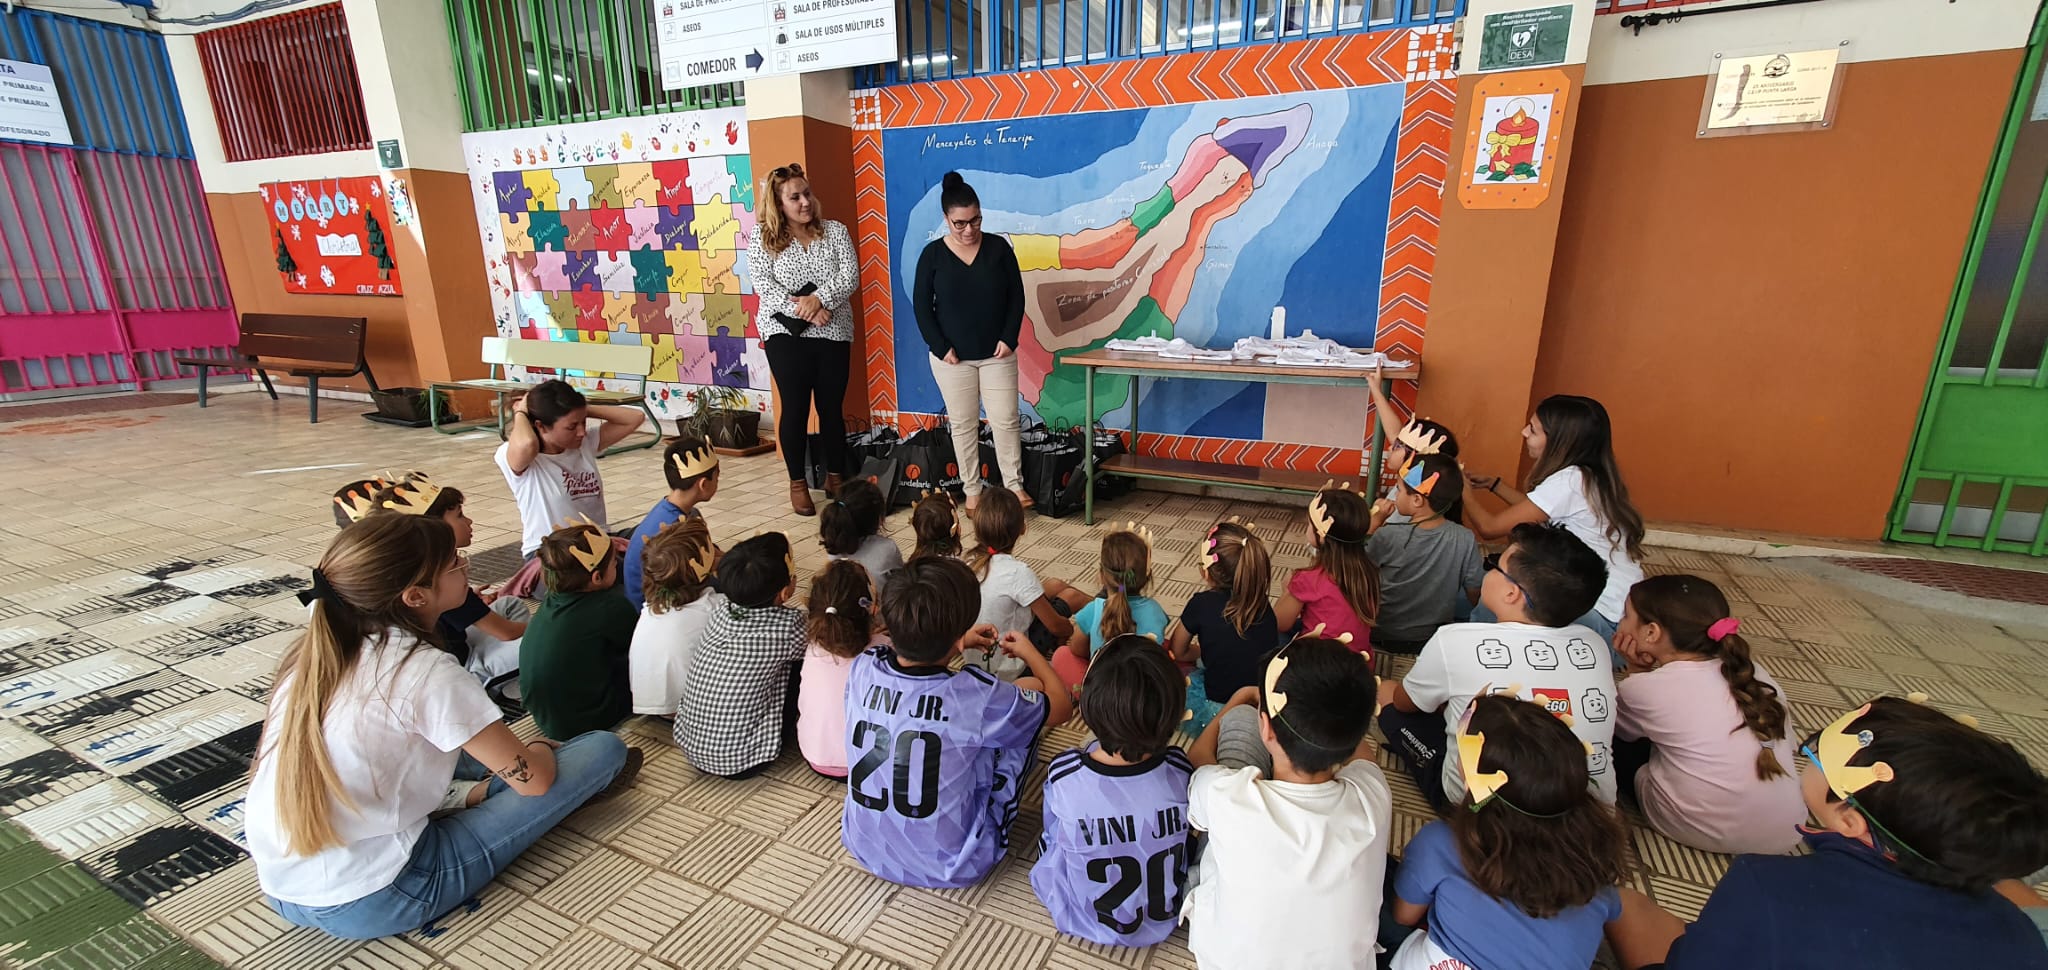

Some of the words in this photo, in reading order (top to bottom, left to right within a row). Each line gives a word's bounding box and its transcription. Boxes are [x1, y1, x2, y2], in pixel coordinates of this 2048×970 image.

[793, 3, 811, 14] SALA
[812, 1, 821, 11] DE
[823, 0, 874, 9] PROFES
[682, 22, 702, 33] ASEOS
[795, 29, 812, 39] SALA
[813, 27, 823, 37] DE
[824, 24, 844, 35] USOS
[845, 18, 885, 32] MÚLTIPLES
[797, 52, 820, 62] ASEOS
[1510, 50, 1534, 60] DESA
[0, 64, 17, 74] TA
[687, 57, 737, 76] COMEDOR
[3, 80, 45, 92] PRIMARIA
[8, 96, 50, 108] PRIMARIA
[0, 125, 51, 137] OFESORADO
[983, 132, 993, 146] de
[277, 199, 346, 218] MERRY
[602, 216, 620, 240] Amor
[356, 284, 374, 294] CRUZ
[378, 284, 396, 294] AZUL
[908, 693, 949, 722] JR.
[1545, 699, 1568, 712] EGO
[851, 719, 942, 819] 20
[1077, 814, 1137, 847] VINI
[1151, 805, 1187, 840] JR.
[1086, 842, 1186, 936] 20
